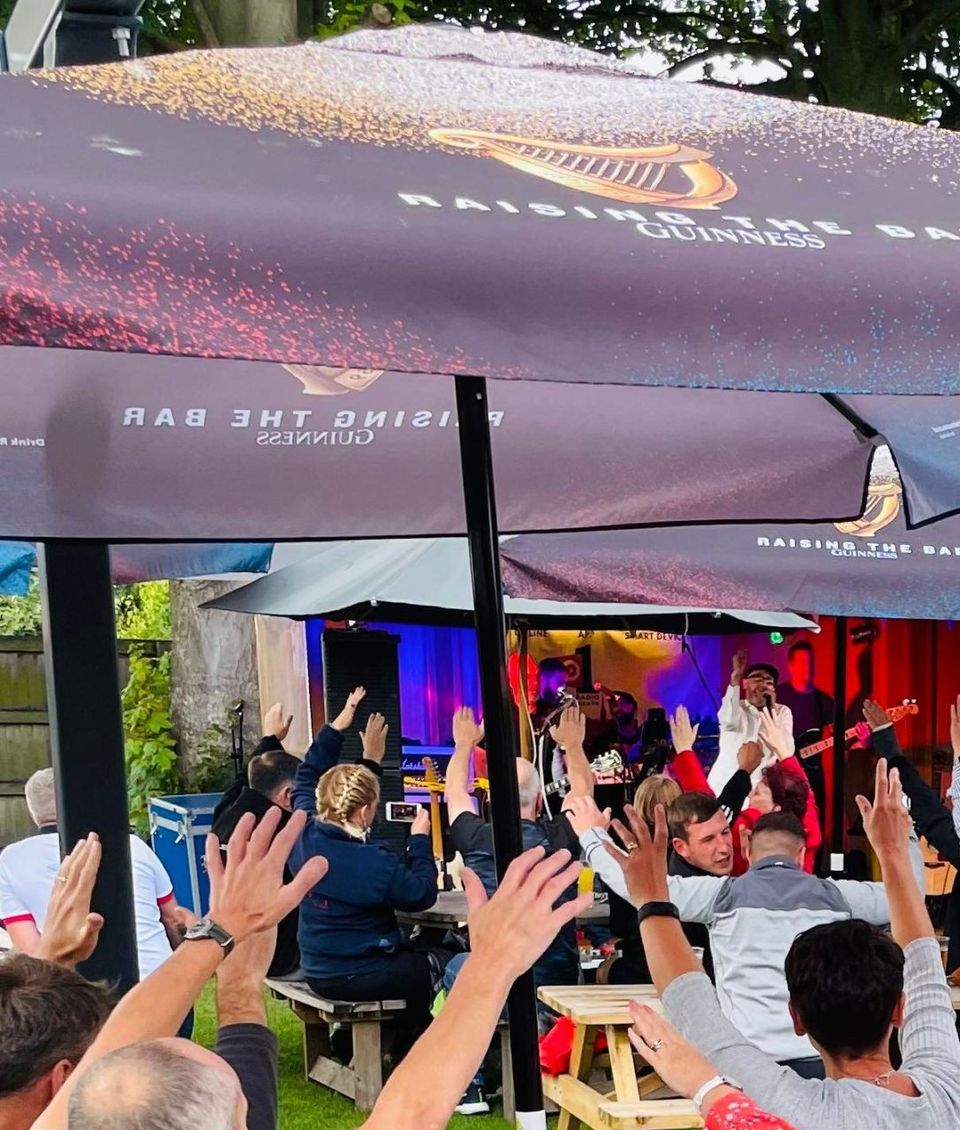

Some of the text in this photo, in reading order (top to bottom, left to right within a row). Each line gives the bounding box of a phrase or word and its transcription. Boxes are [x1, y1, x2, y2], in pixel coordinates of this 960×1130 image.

[398, 193, 698, 225] RAISING
[722, 215, 852, 235] THE
[636, 221, 827, 250] GUINNESS
[757, 537, 856, 551] RAISING
[867, 542, 912, 555] THE
[831, 549, 898, 560] GUINNESS
[656, 633, 683, 641] DEVIC
